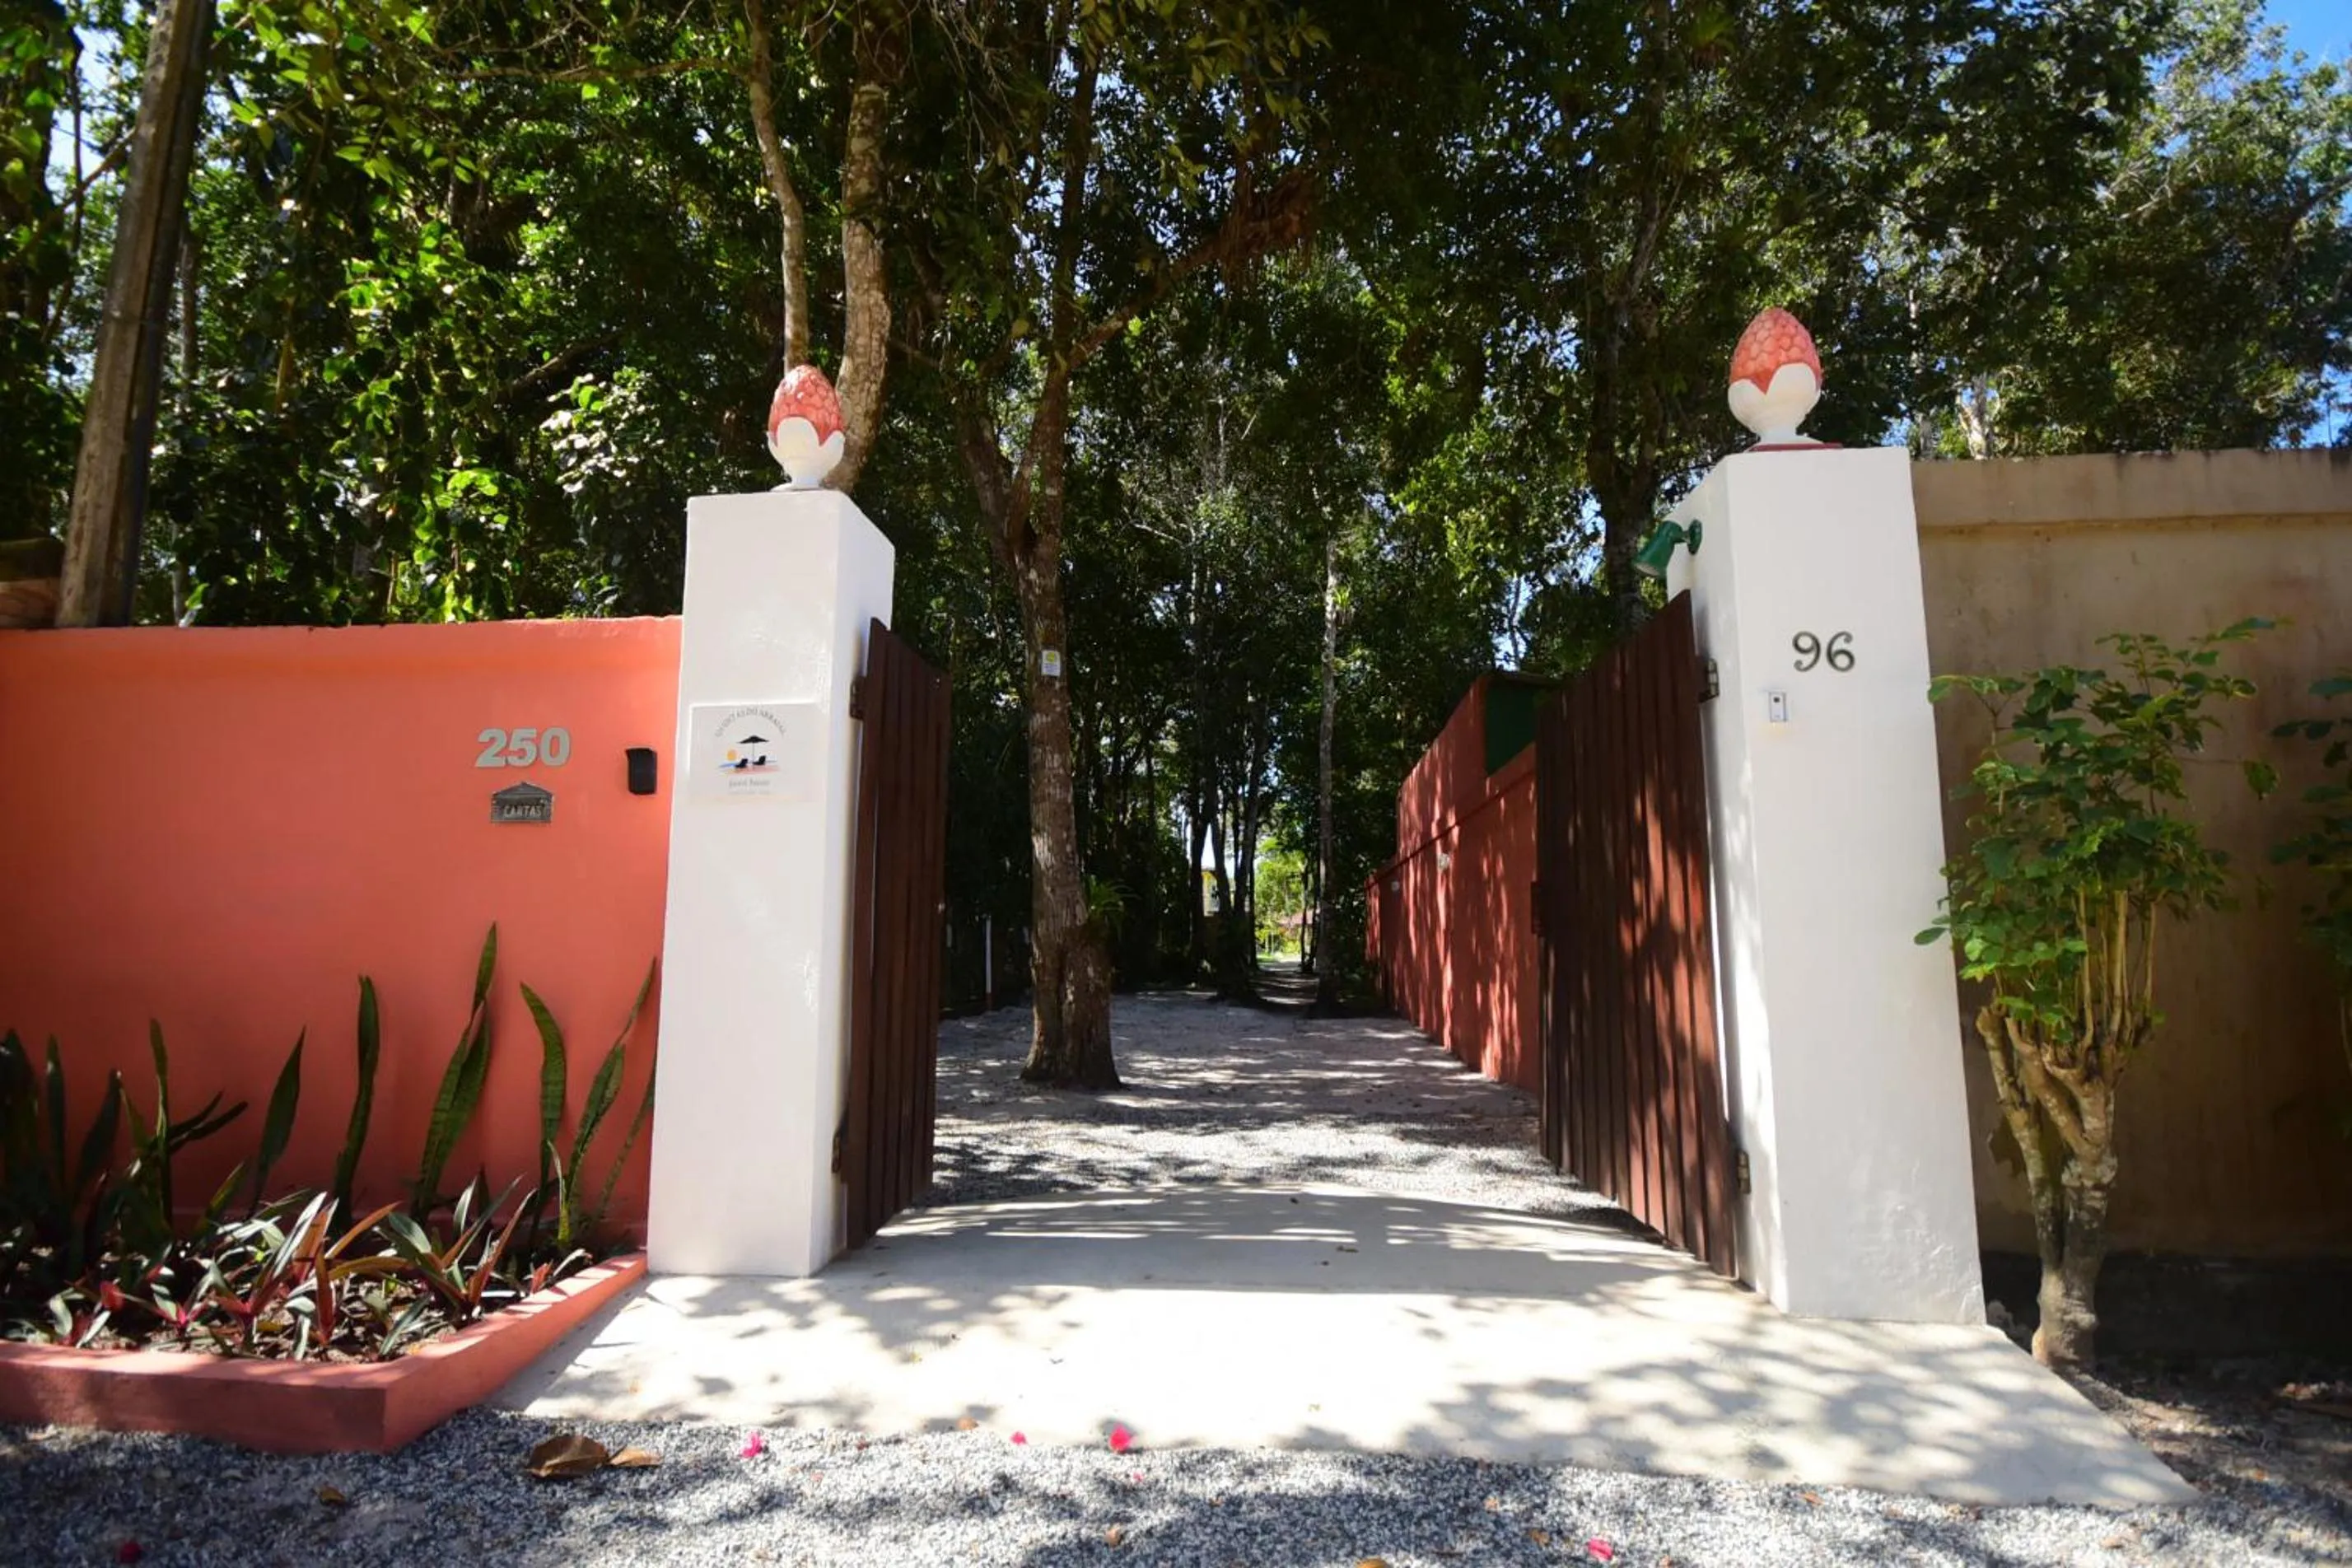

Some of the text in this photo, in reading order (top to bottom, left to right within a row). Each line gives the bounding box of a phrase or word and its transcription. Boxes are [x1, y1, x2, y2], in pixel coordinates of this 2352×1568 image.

[1792, 631, 1855, 672] 96
[474, 726, 572, 768] 250
[503, 805, 542, 818] CARTAS
